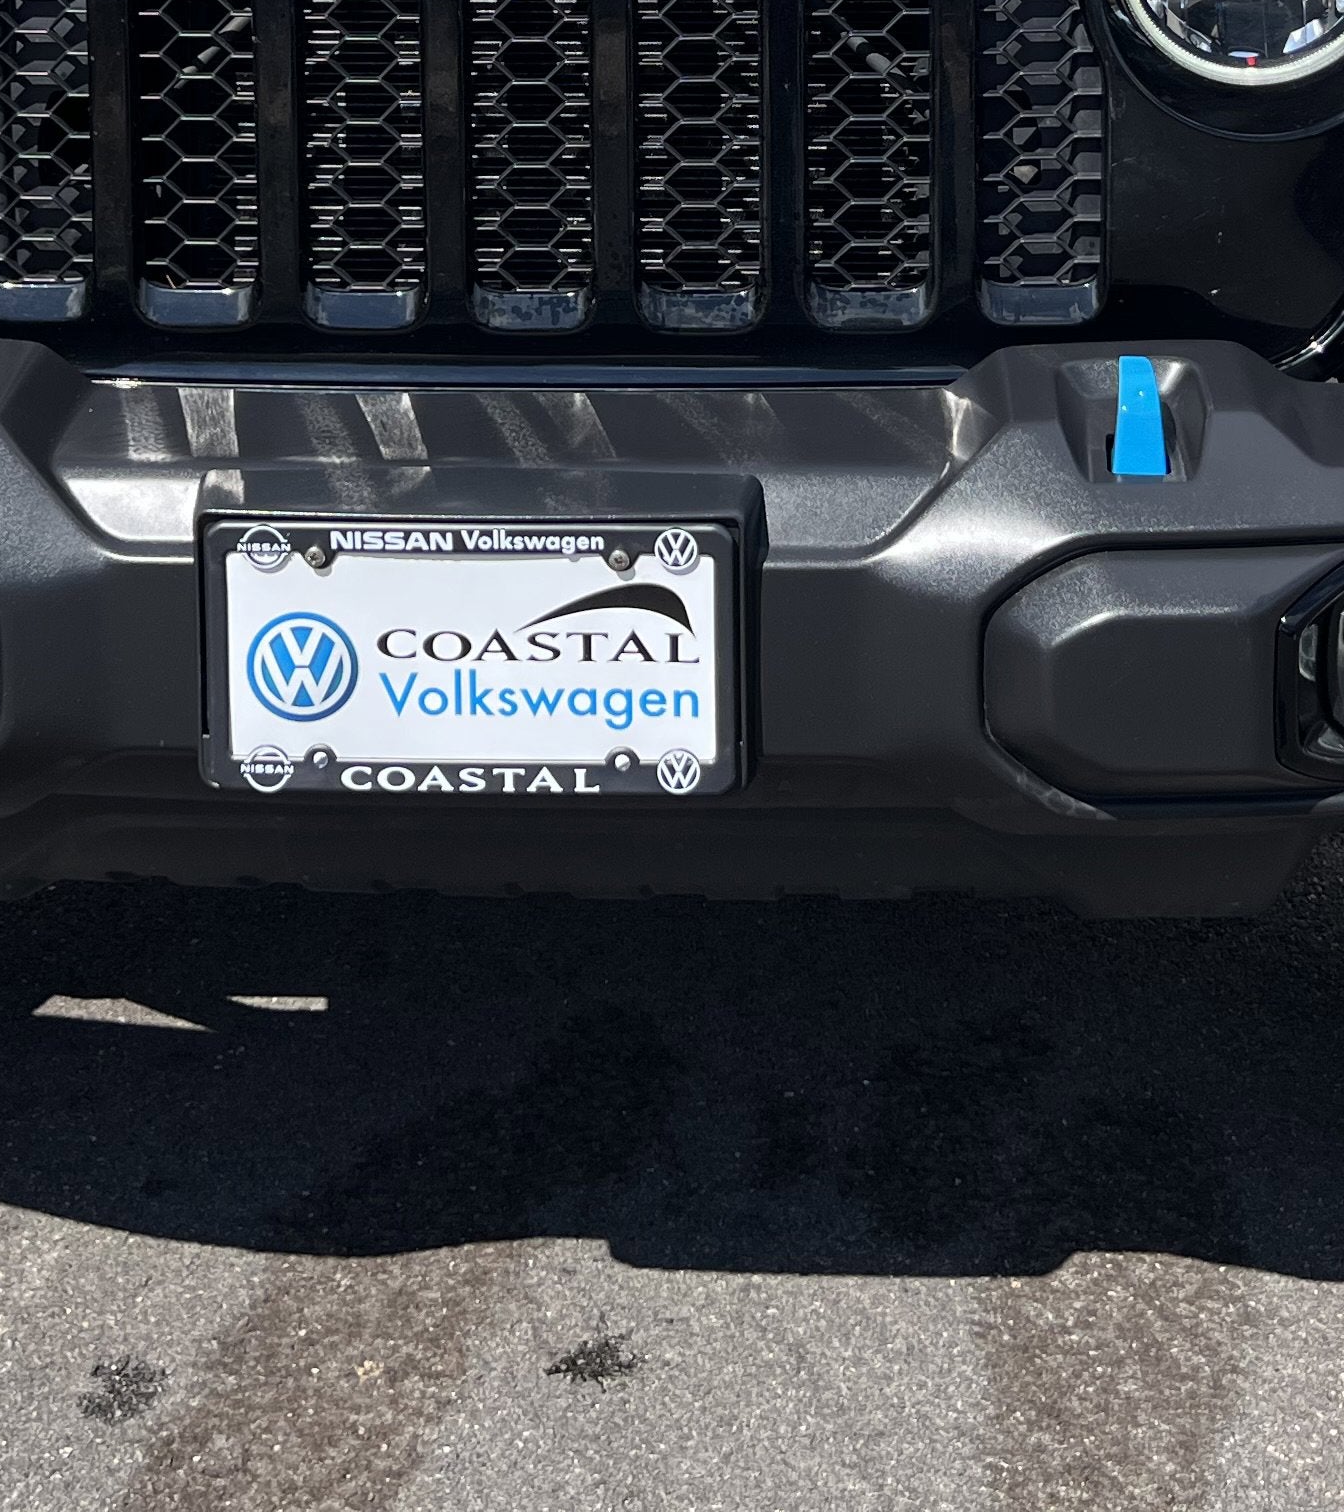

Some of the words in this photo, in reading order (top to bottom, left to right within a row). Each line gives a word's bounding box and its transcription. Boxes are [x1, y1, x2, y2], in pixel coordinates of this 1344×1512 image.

[237, 542, 291, 552] NISSAN
[330, 531, 452, 550] NISSAN
[461, 529, 604, 554] Volkswagen
[376, 628, 700, 664] COASTAL
[379, 669, 698, 729] Volkswagen
[240, 763, 294, 774] NISSAN
[340, 765, 600, 793] COASTAL
